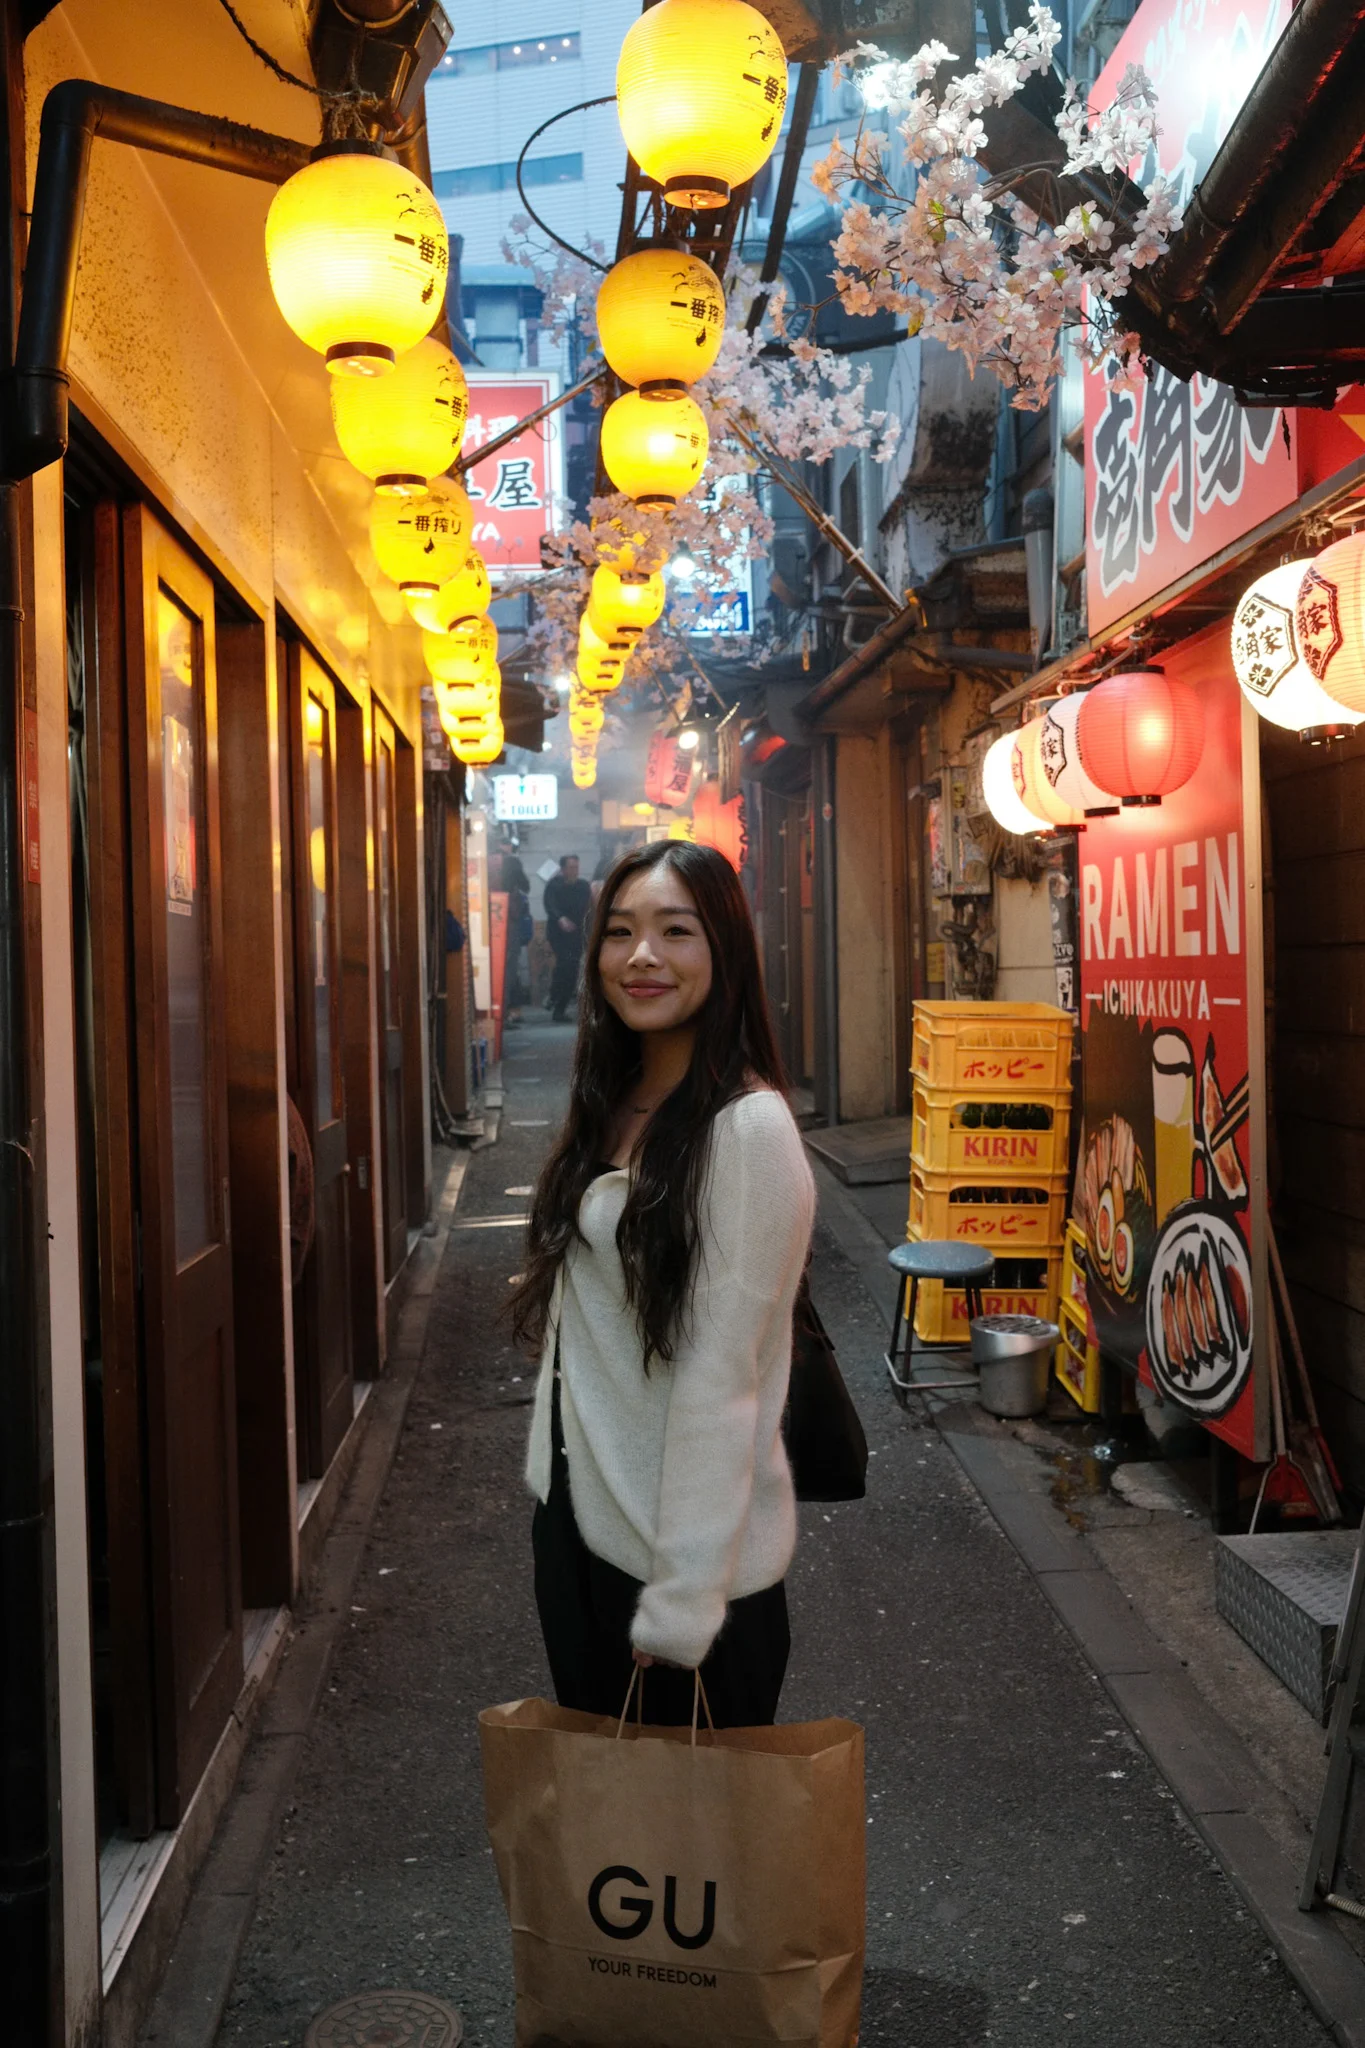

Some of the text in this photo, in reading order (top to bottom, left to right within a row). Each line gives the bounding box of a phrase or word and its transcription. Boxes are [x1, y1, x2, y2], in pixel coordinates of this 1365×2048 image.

[398, 515, 462, 535] 一番搾り
[511, 804, 549, 816] TOILET
[1083, 832, 1240, 961] RAMEN
[1103, 979, 1211, 1021] ICHIKAKUYA
[963, 1057, 1045, 1079] ホッピー
[963, 1136, 1038, 1157] KIRIN
[957, 1213, 1038, 1235] ホッピー
[588, 1865, 717, 1950] GU
[588, 1956, 717, 1988] YOUR FREEDOM
